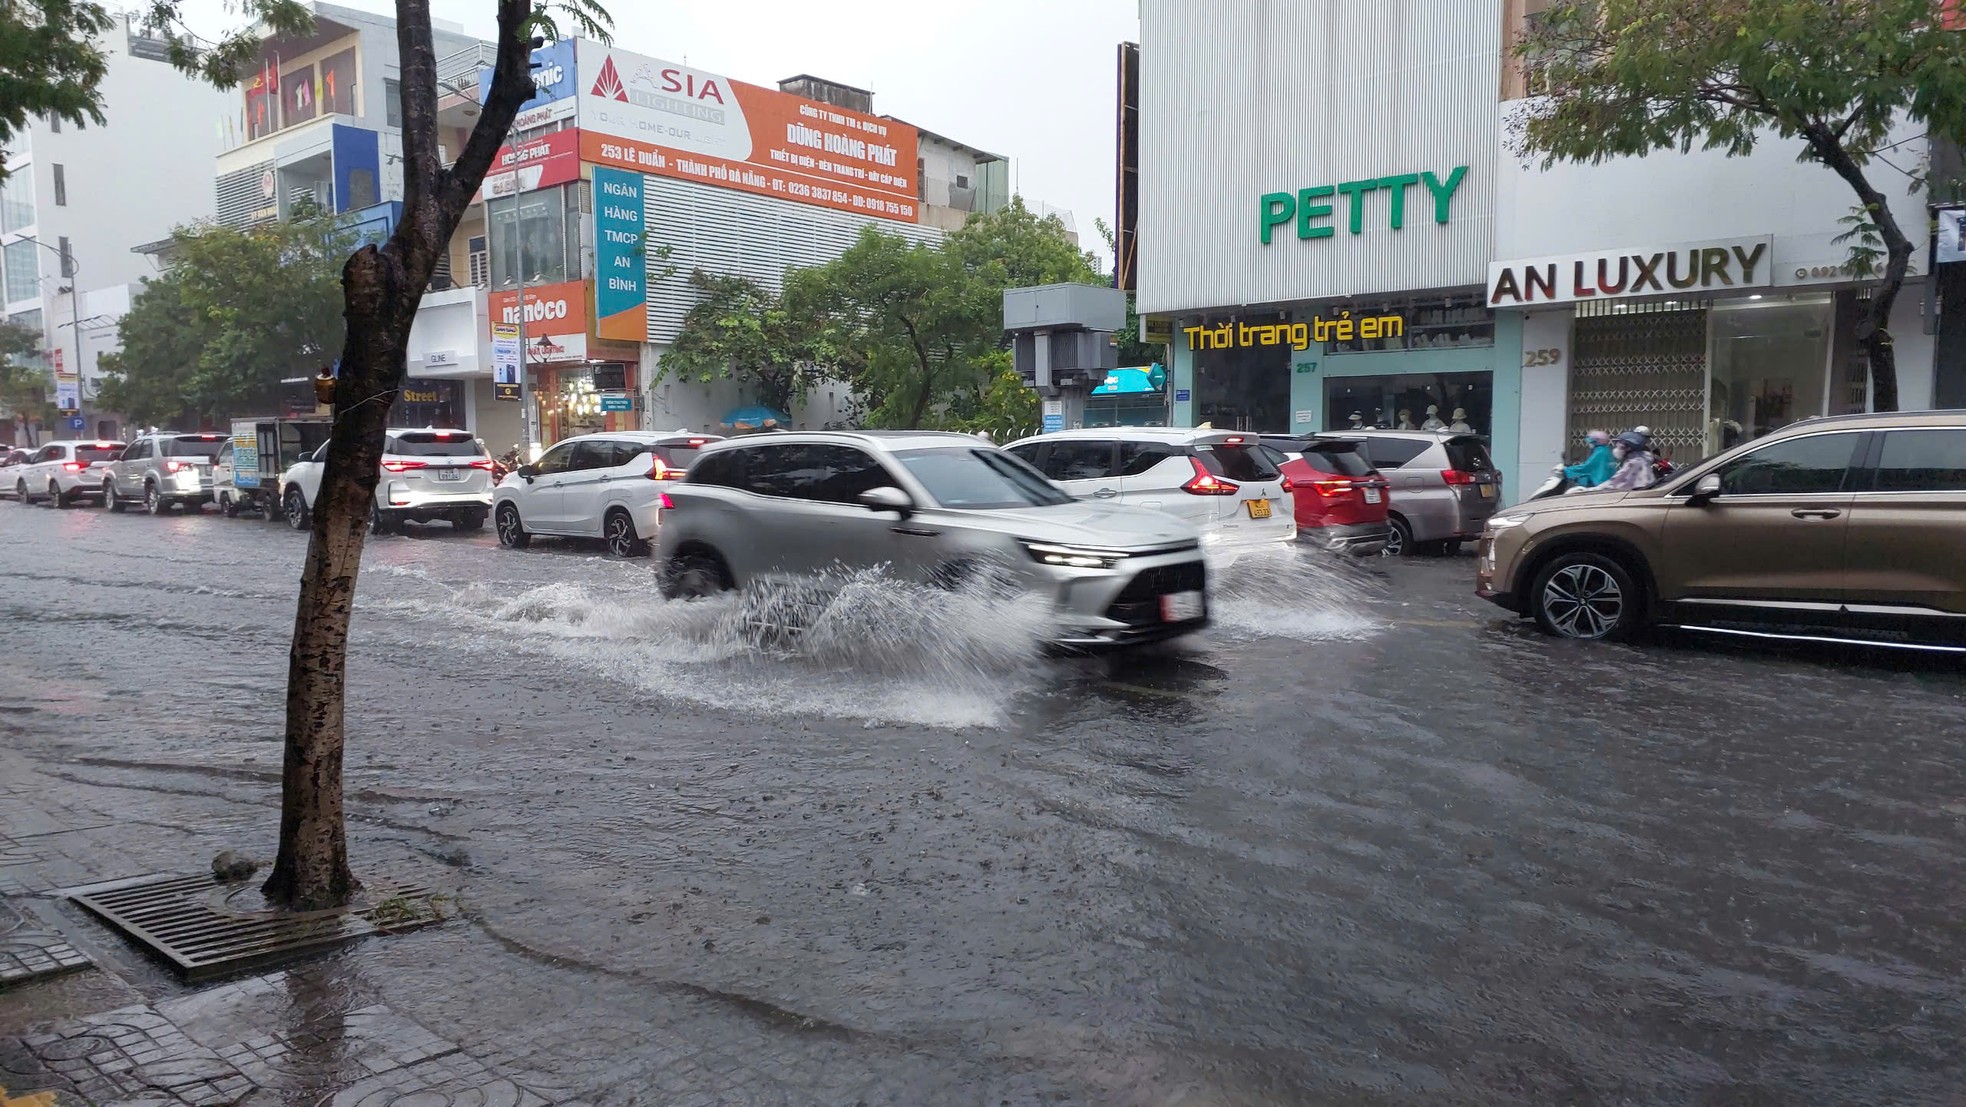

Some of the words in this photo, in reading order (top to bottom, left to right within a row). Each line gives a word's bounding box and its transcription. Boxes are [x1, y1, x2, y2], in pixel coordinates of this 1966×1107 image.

[819, 109, 828, 120] TY
[846, 116, 856, 128] TM
[786, 122, 822, 149] DŨNG
[824, 133, 865, 160] HOÀNG
[867, 144, 897, 166] PHÁT
[833, 163, 853, 177] TRANG
[601, 143, 622, 160] 253
[624, 147, 636, 162] LÊ
[638, 150, 665, 168] DUẨN
[676, 159, 707, 177] THÀNH
[708, 164, 727, 180] PHỐ
[728, 168, 741, 183] ĐÀ
[788, 182, 810, 196] 0236
[811, 186, 831, 200] 3837
[832, 191, 848, 204] 854
[866, 198, 884, 211] 0918
[885, 201, 898, 214] 755
[899, 204, 913, 216] 150
[604, 182, 637, 198] NGÂN
[604, 205, 638, 221] HÀNG
[1260, 166, 1469, 244] PETTY
[604, 229, 638, 244] TMCP
[614, 256, 631, 268] AN
[1491, 263, 1557, 304] AN
[1573, 243, 1767, 297] LUXURY
[608, 276, 637, 292] BÌNH
[1184, 322, 1234, 351] Thời
[1239, 321, 1309, 351] trang
[1314, 311, 1354, 342] trẻ
[1360, 315, 1403, 339] em
[1523, 349, 1561, 368] 259
[1296, 362, 1317, 374] 257
[403, 389, 437, 402] Street
[74, 419, 82, 428] P
